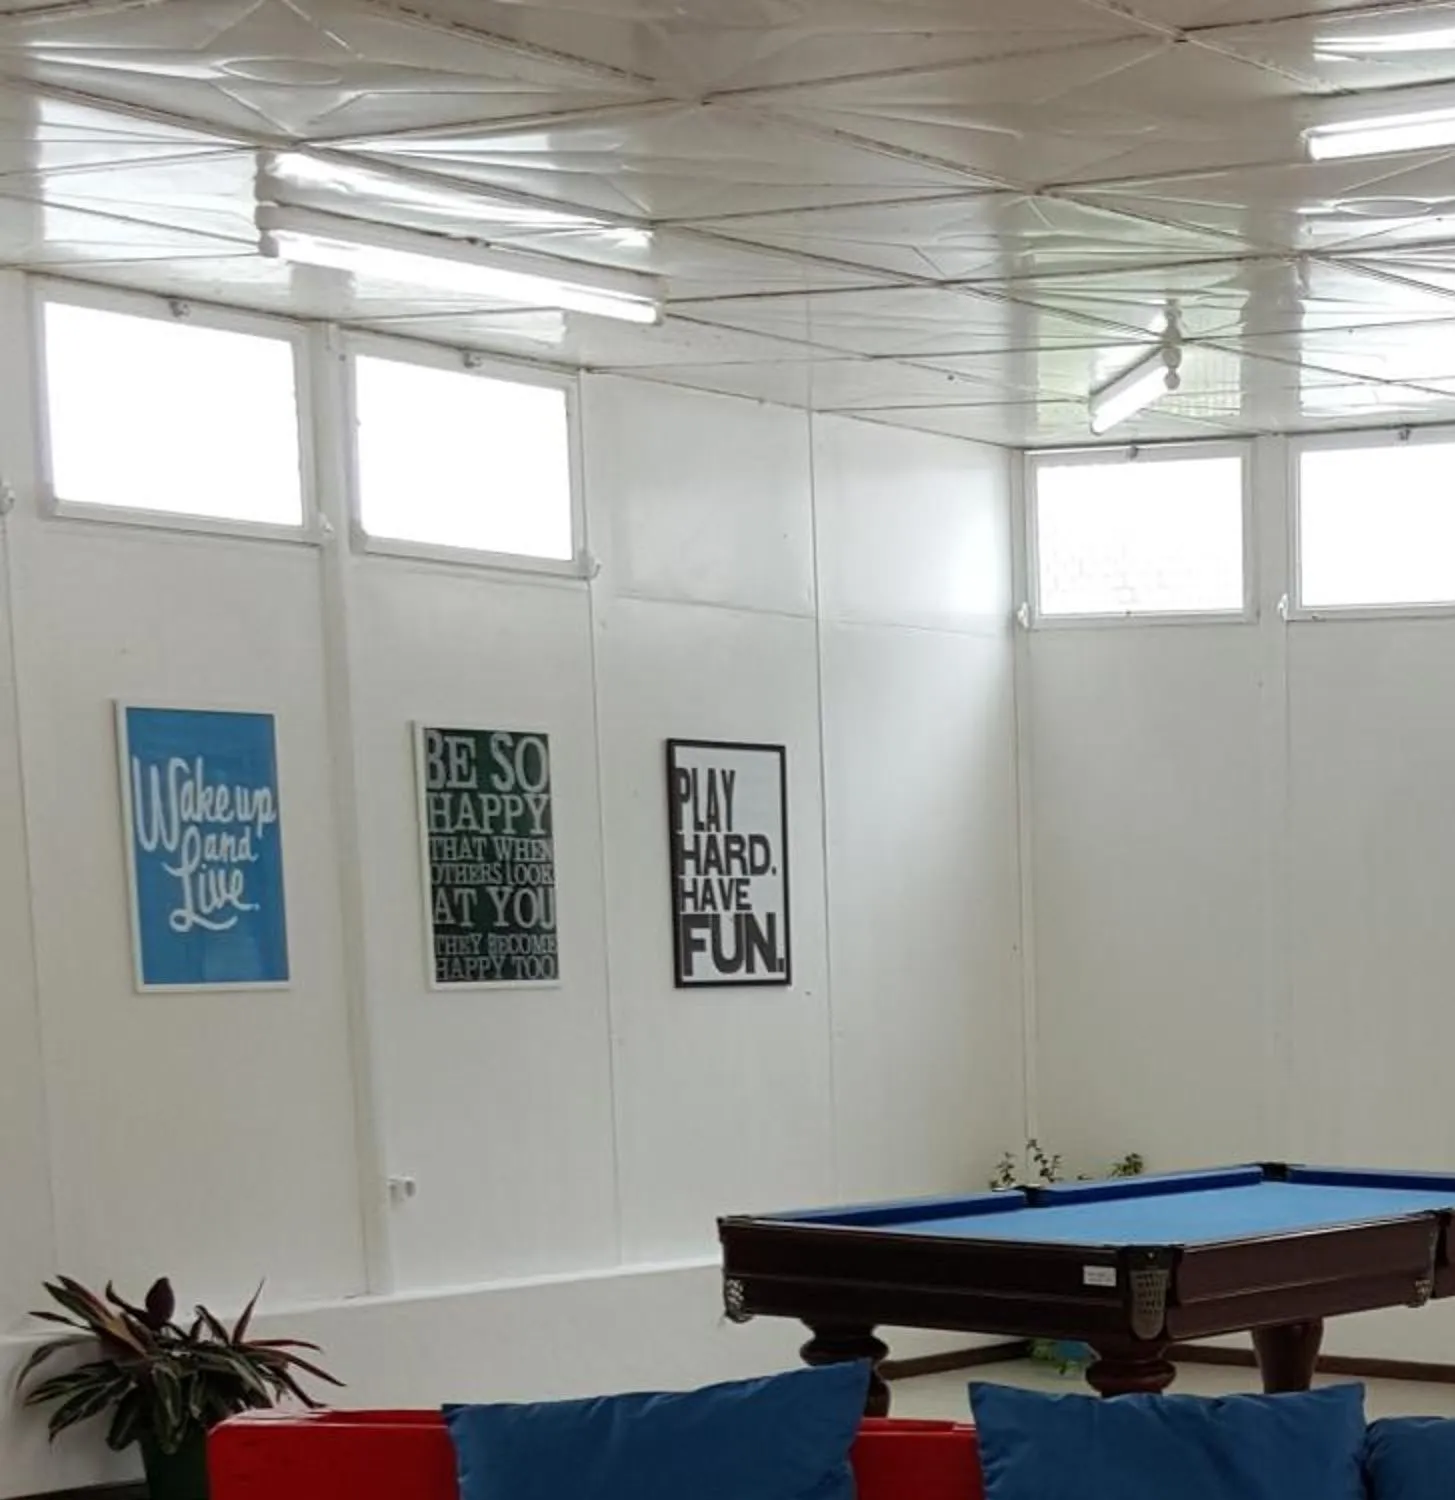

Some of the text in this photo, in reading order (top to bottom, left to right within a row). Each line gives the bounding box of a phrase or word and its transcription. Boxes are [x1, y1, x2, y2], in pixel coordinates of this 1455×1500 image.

[426, 730, 549, 793] BE SO
[132, 755, 276, 851] Wake up
[428, 792, 549, 835] HAPPY
[675, 767, 736, 832] PLAY
[203, 828, 259, 863] and
[431, 837, 552, 862] THAT WHEN
[677, 834, 777, 876] HARD.
[431, 863, 554, 885] OTHERS LOOK
[681, 878, 752, 912] HAVE
[434, 886, 555, 930] AT YOU
[436, 933, 556, 955] THEY BECOME
[682, 912, 785, 976] FUN.
[436, 956, 505, 980] HAPPY
